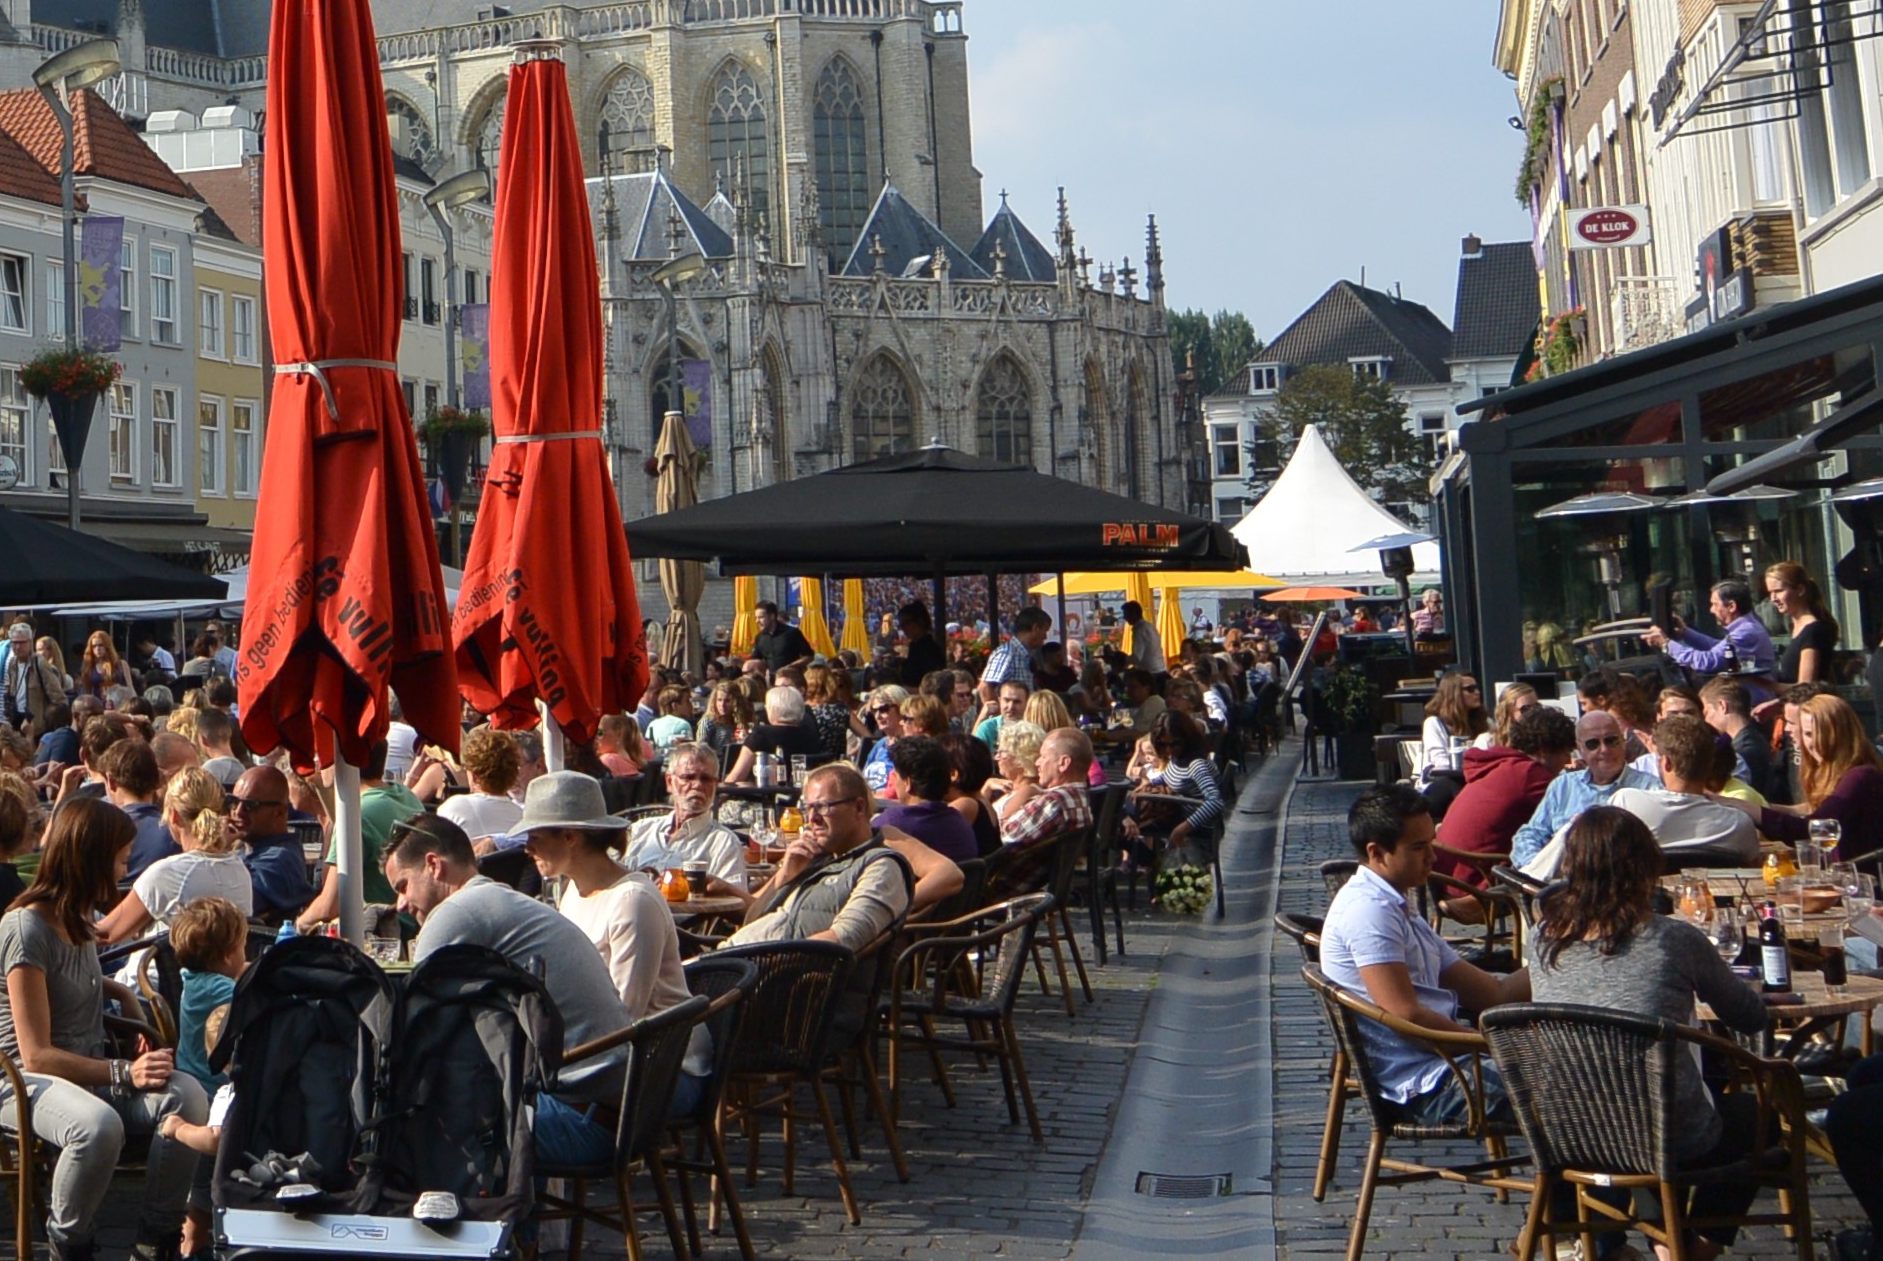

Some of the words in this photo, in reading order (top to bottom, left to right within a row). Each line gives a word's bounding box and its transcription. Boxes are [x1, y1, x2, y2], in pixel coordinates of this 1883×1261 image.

[1584, 223, 1600, 234] DE
[1601, 221, 1630, 233] KLOK
[1102, 523, 1180, 548] PALM
[247, 622, 283, 671] geen
